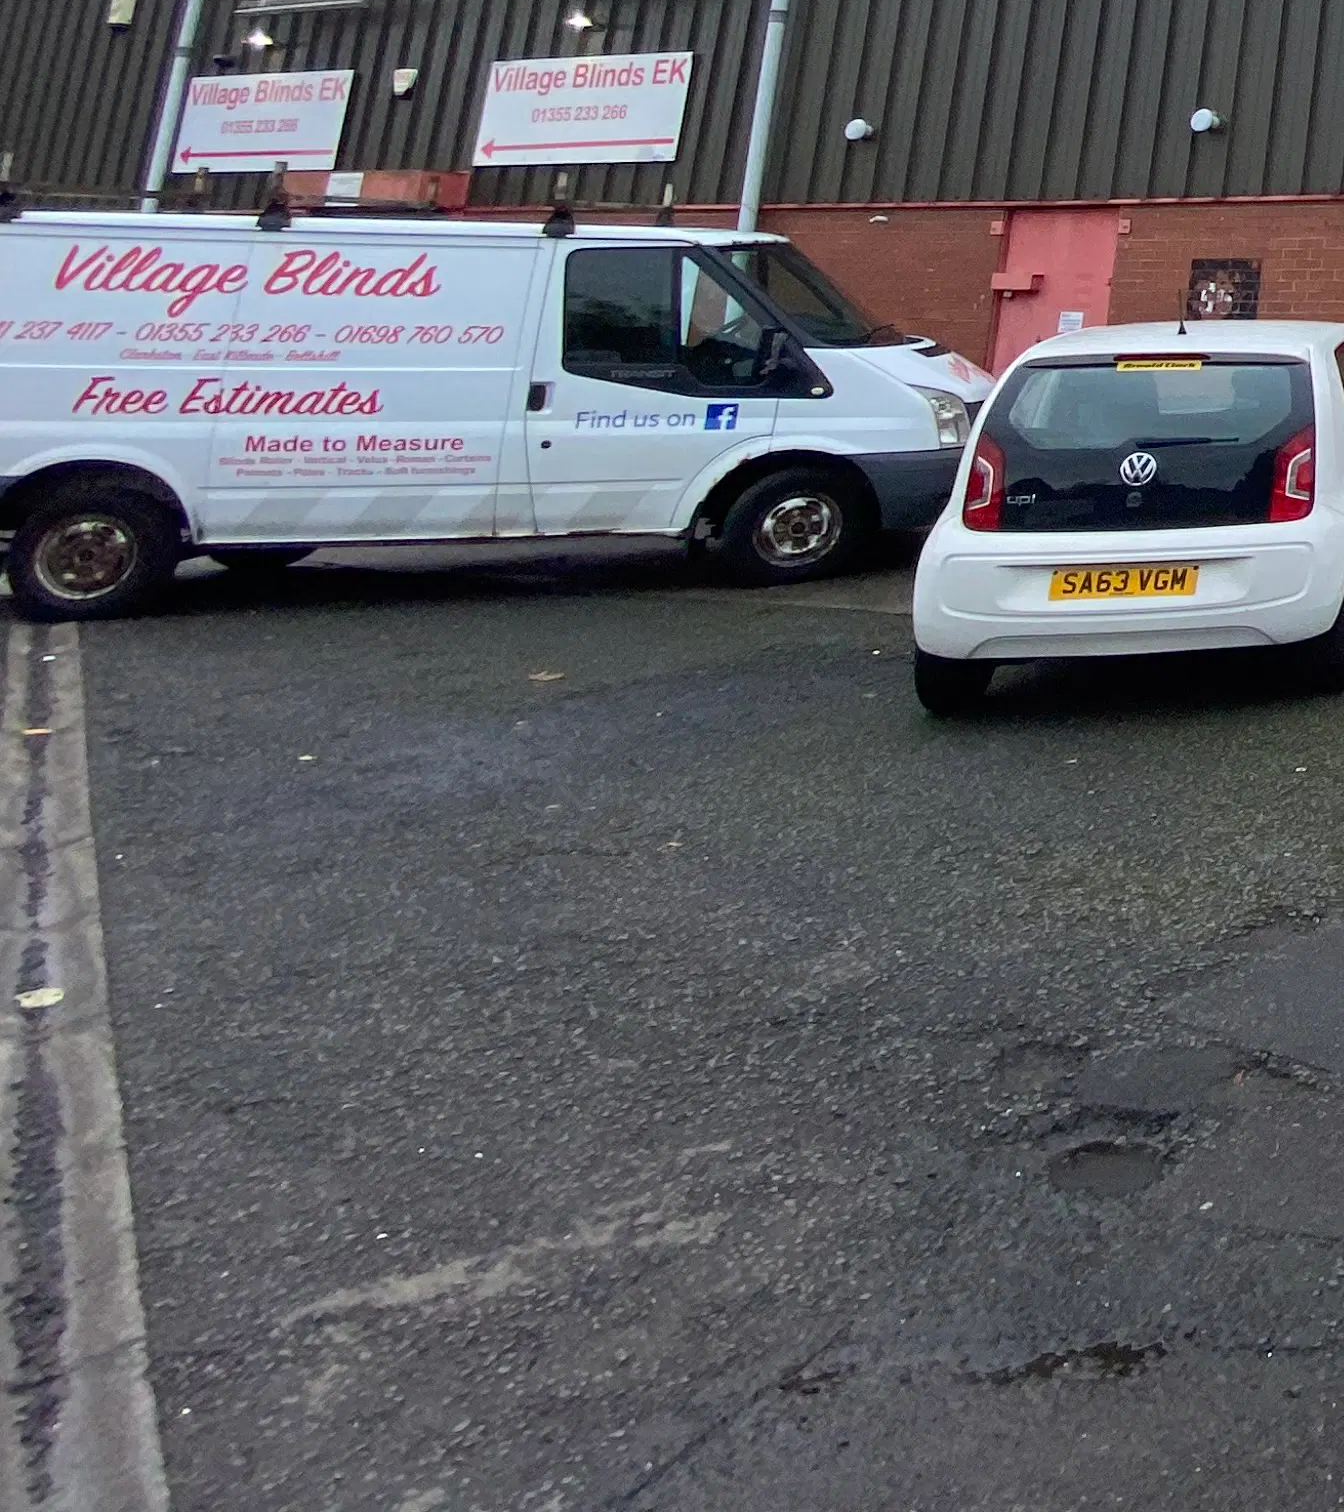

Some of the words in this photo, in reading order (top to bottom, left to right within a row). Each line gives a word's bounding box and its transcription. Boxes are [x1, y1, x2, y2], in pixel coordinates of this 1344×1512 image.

[492, 66, 567, 95] Village
[572, 61, 645, 88] Blinds
[652, 58, 688, 85] EK
[191, 83, 250, 110] Village
[254, 79, 313, 104] Blinds
[318, 76, 347, 101] EK
[531, 107, 572, 123] 01355
[574, 106, 600, 121] 233
[601, 104, 628, 120] 266
[54, 244, 249, 318] Village
[263, 249, 442, 297] Blinds
[12, 320, 64, 340] 237
[66, 321, 114, 340] 4117
[135, 322, 212, 342] 01355
[208, 323, 260, 343] 233
[259, 324, 312, 344] 266
[333, 325, 406, 345] 01698
[406, 325, 453, 345] 760
[457, 325, 505, 345] 570
[72, 376, 169, 416] Free
[178, 377, 384, 416] Estimates
[575, 410, 627, 429] Find
[634, 414, 660, 427] us
[667, 413, 696, 427] on
[244, 435, 314, 453] Made
[322, 436, 347, 452] to
[356, 435, 464, 452] Measure
[1062, 570, 1130, 594] SA63
[1139, 568, 1188, 591] VGM
